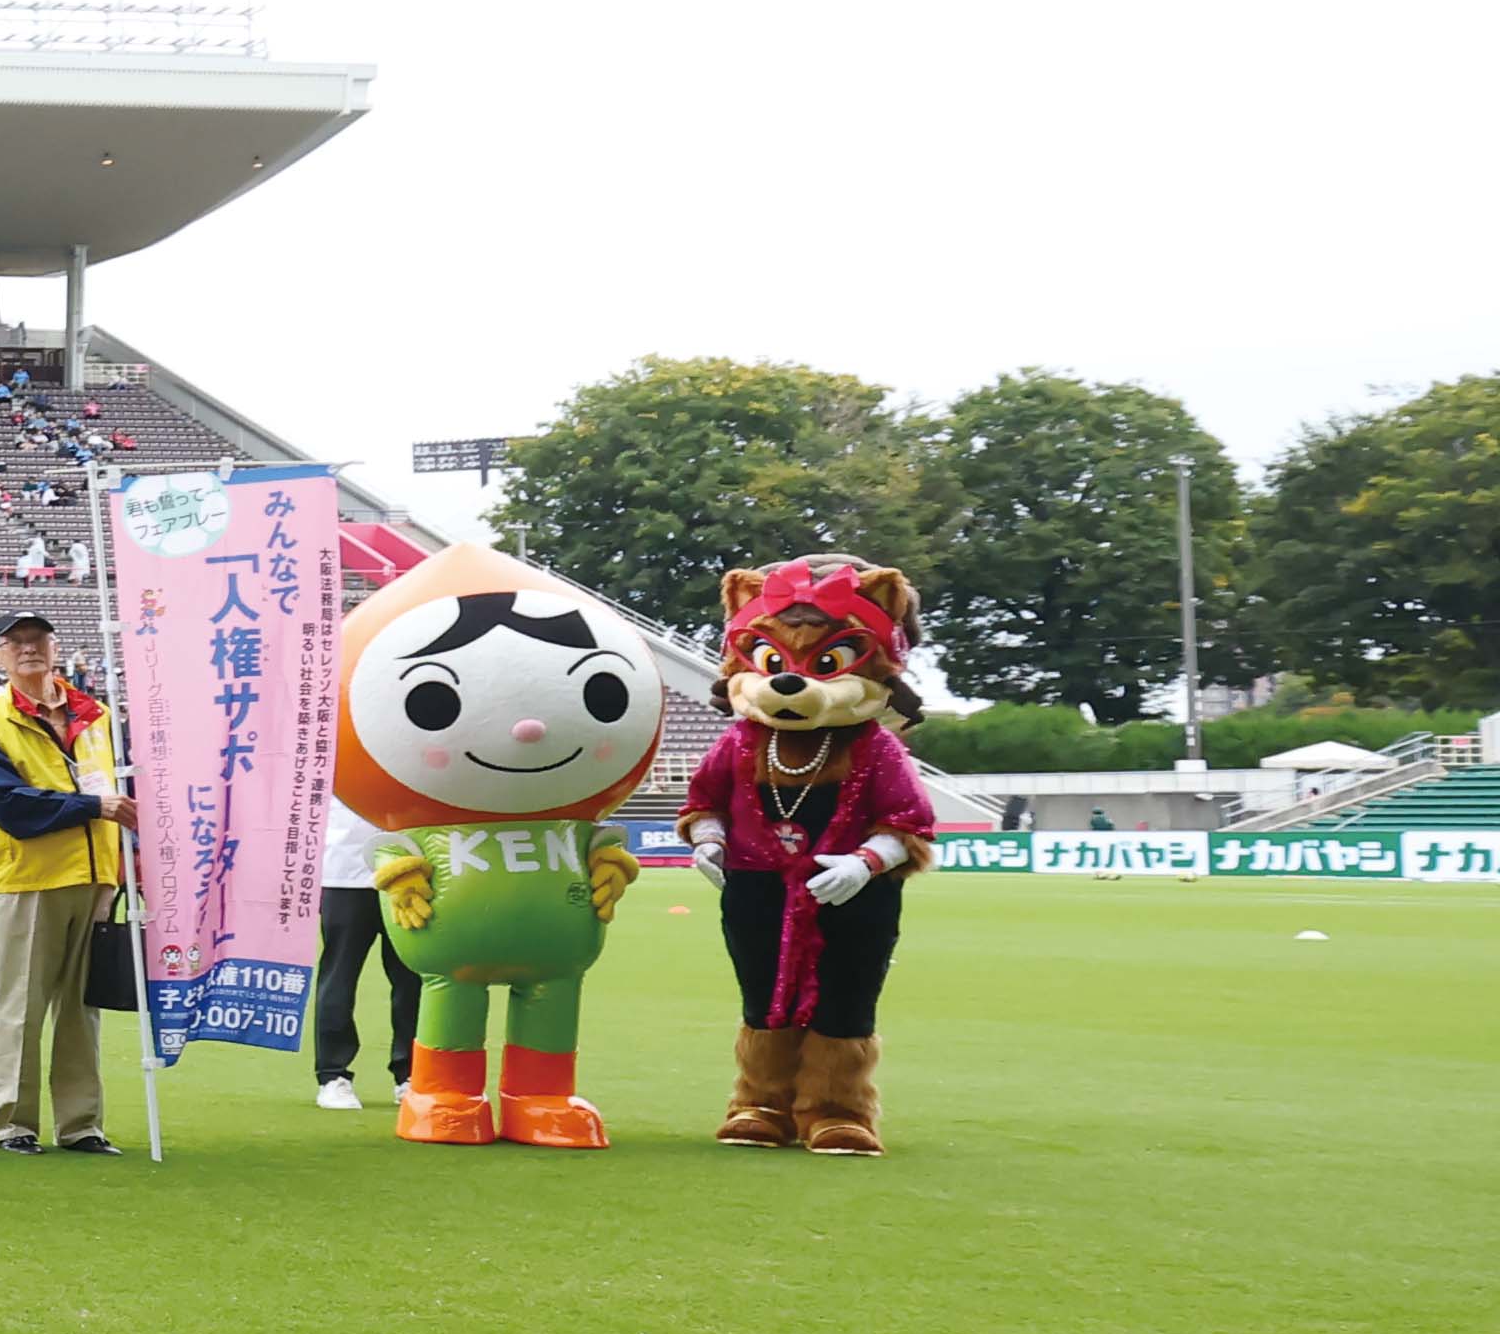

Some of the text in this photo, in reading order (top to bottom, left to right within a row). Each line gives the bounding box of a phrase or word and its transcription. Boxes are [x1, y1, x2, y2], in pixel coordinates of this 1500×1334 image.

[264, 490, 300, 616] みんなで
[449, 826, 583, 877] KEN
[1043, 840, 1197, 869] ナカバヤシ
[1214, 840, 1395, 872] ナカバヤシ
